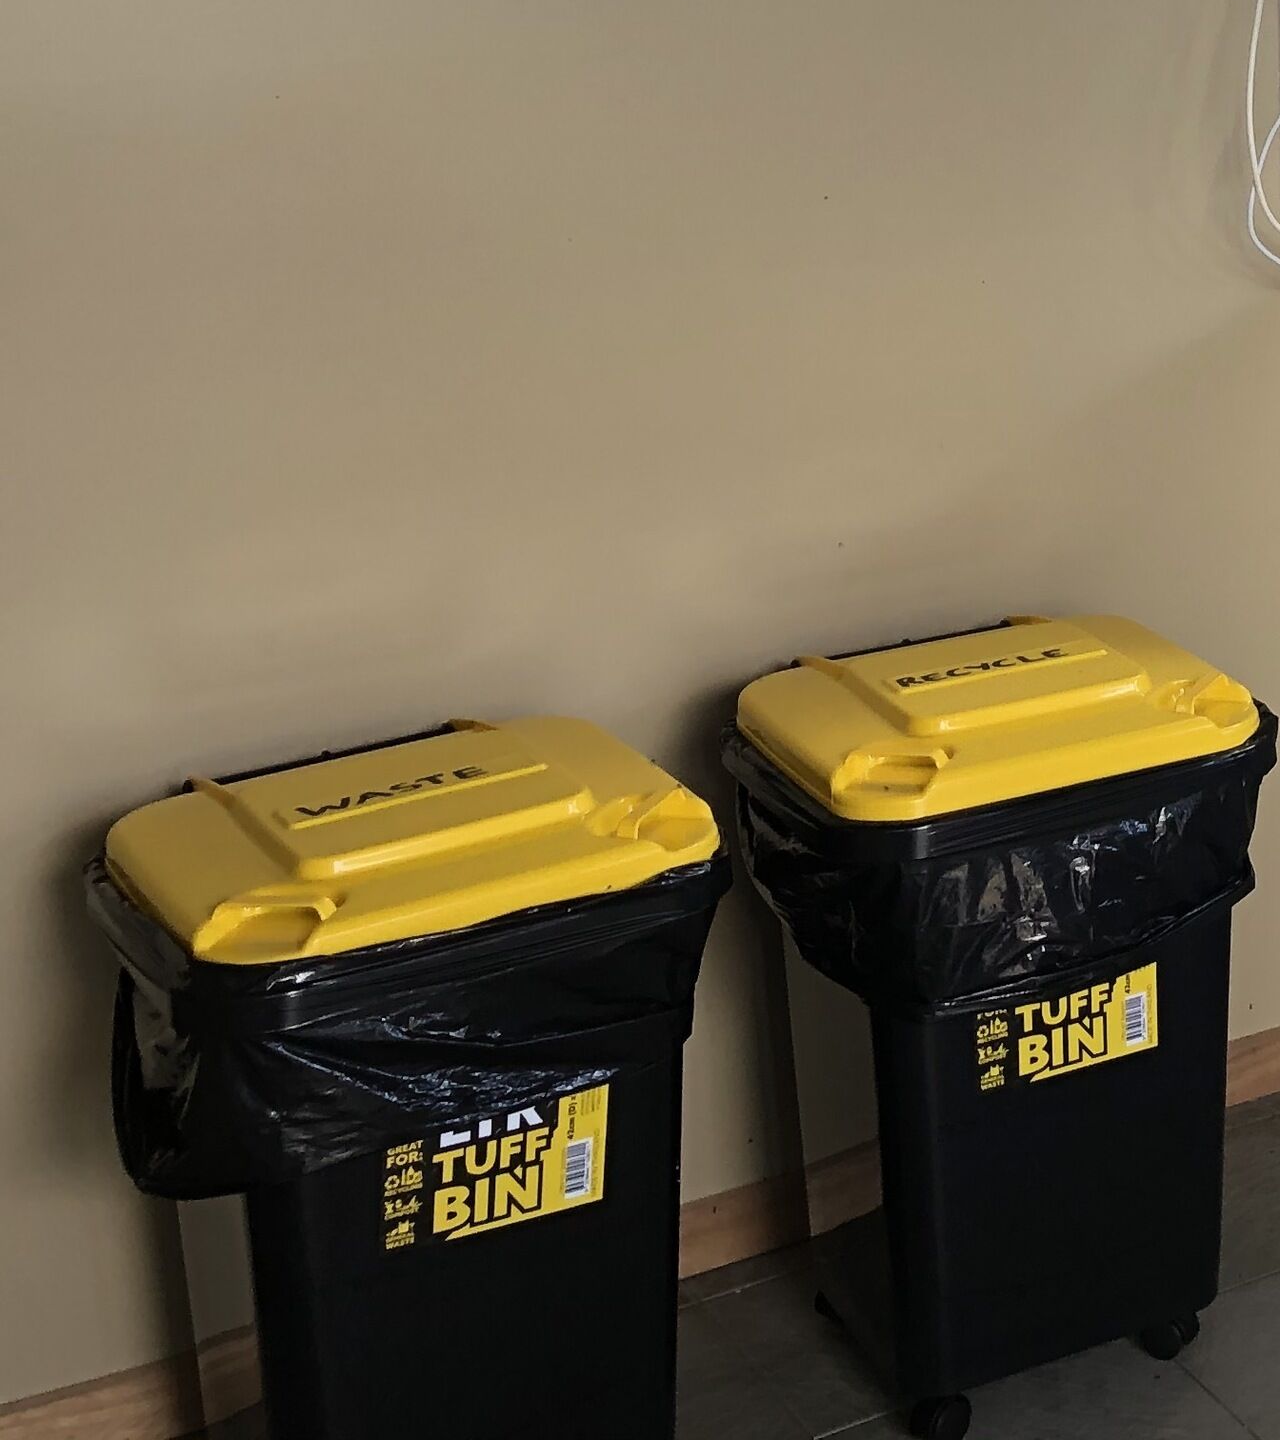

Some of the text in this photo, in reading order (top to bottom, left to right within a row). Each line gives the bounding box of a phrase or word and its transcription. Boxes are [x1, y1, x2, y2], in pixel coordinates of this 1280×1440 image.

[896, 648, 1068, 687] RECYCLE
[294, 766, 488, 816] WASTE
[1015, 982, 1110, 1033] TUFF
[1018, 1015, 1105, 1077] BIN
[386, 1140, 424, 1156] GREAT
[386, 1151, 424, 1169] FOR:
[432, 1126, 550, 1184] TUFF
[433, 1165, 540, 1234] BIN
